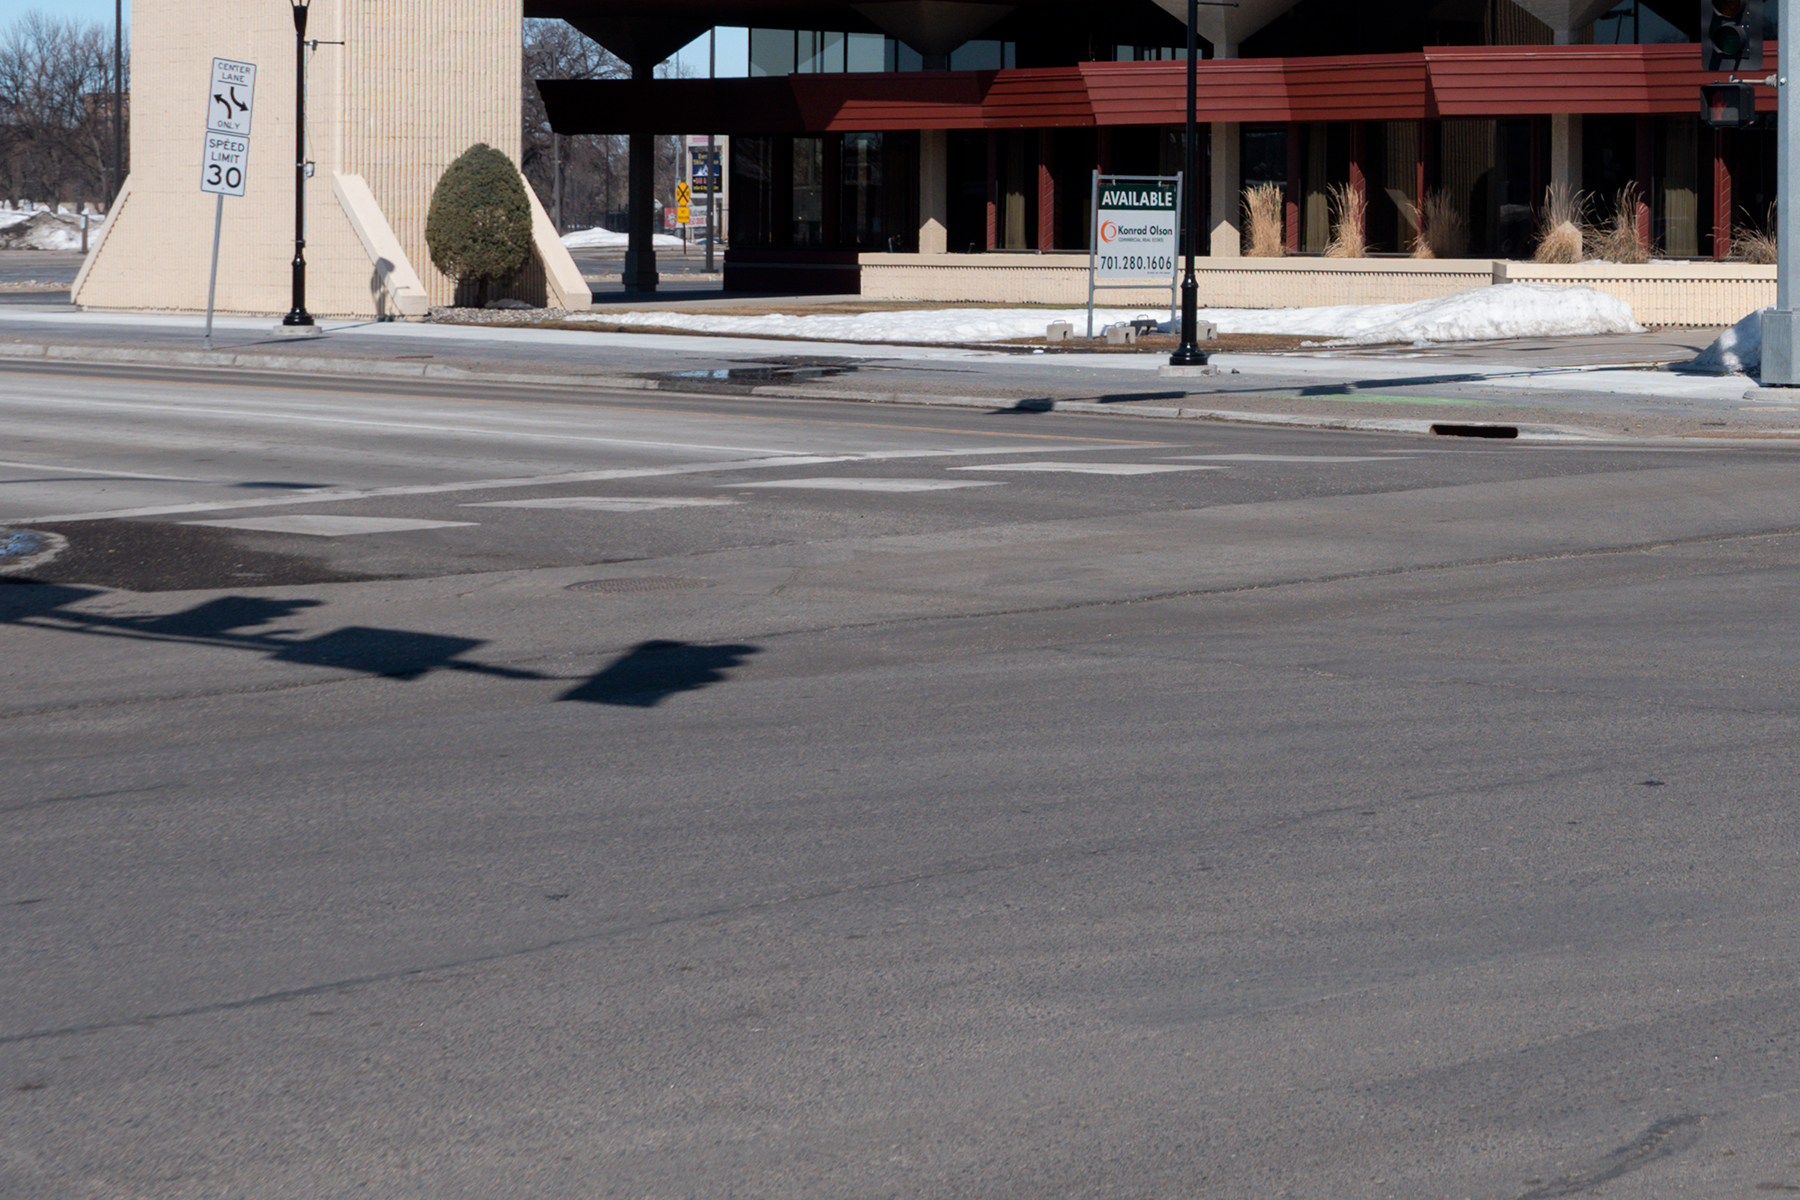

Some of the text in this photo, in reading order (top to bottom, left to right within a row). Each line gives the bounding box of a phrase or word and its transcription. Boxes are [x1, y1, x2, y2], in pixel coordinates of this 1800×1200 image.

[217, 62, 251, 74] CENTER
[221, 72, 245, 83] LANE
[217, 120, 241, 130] ONLY
[209, 139, 245, 152] SPEED
[211, 151, 240, 164] LIMIT
[206, 164, 242, 188] 30
[1101, 191, 1172, 206] AVAILABLE
[1117, 225, 1173, 236] Konrad Olson
[1100, 255, 1172, 270] 701.280.1606
